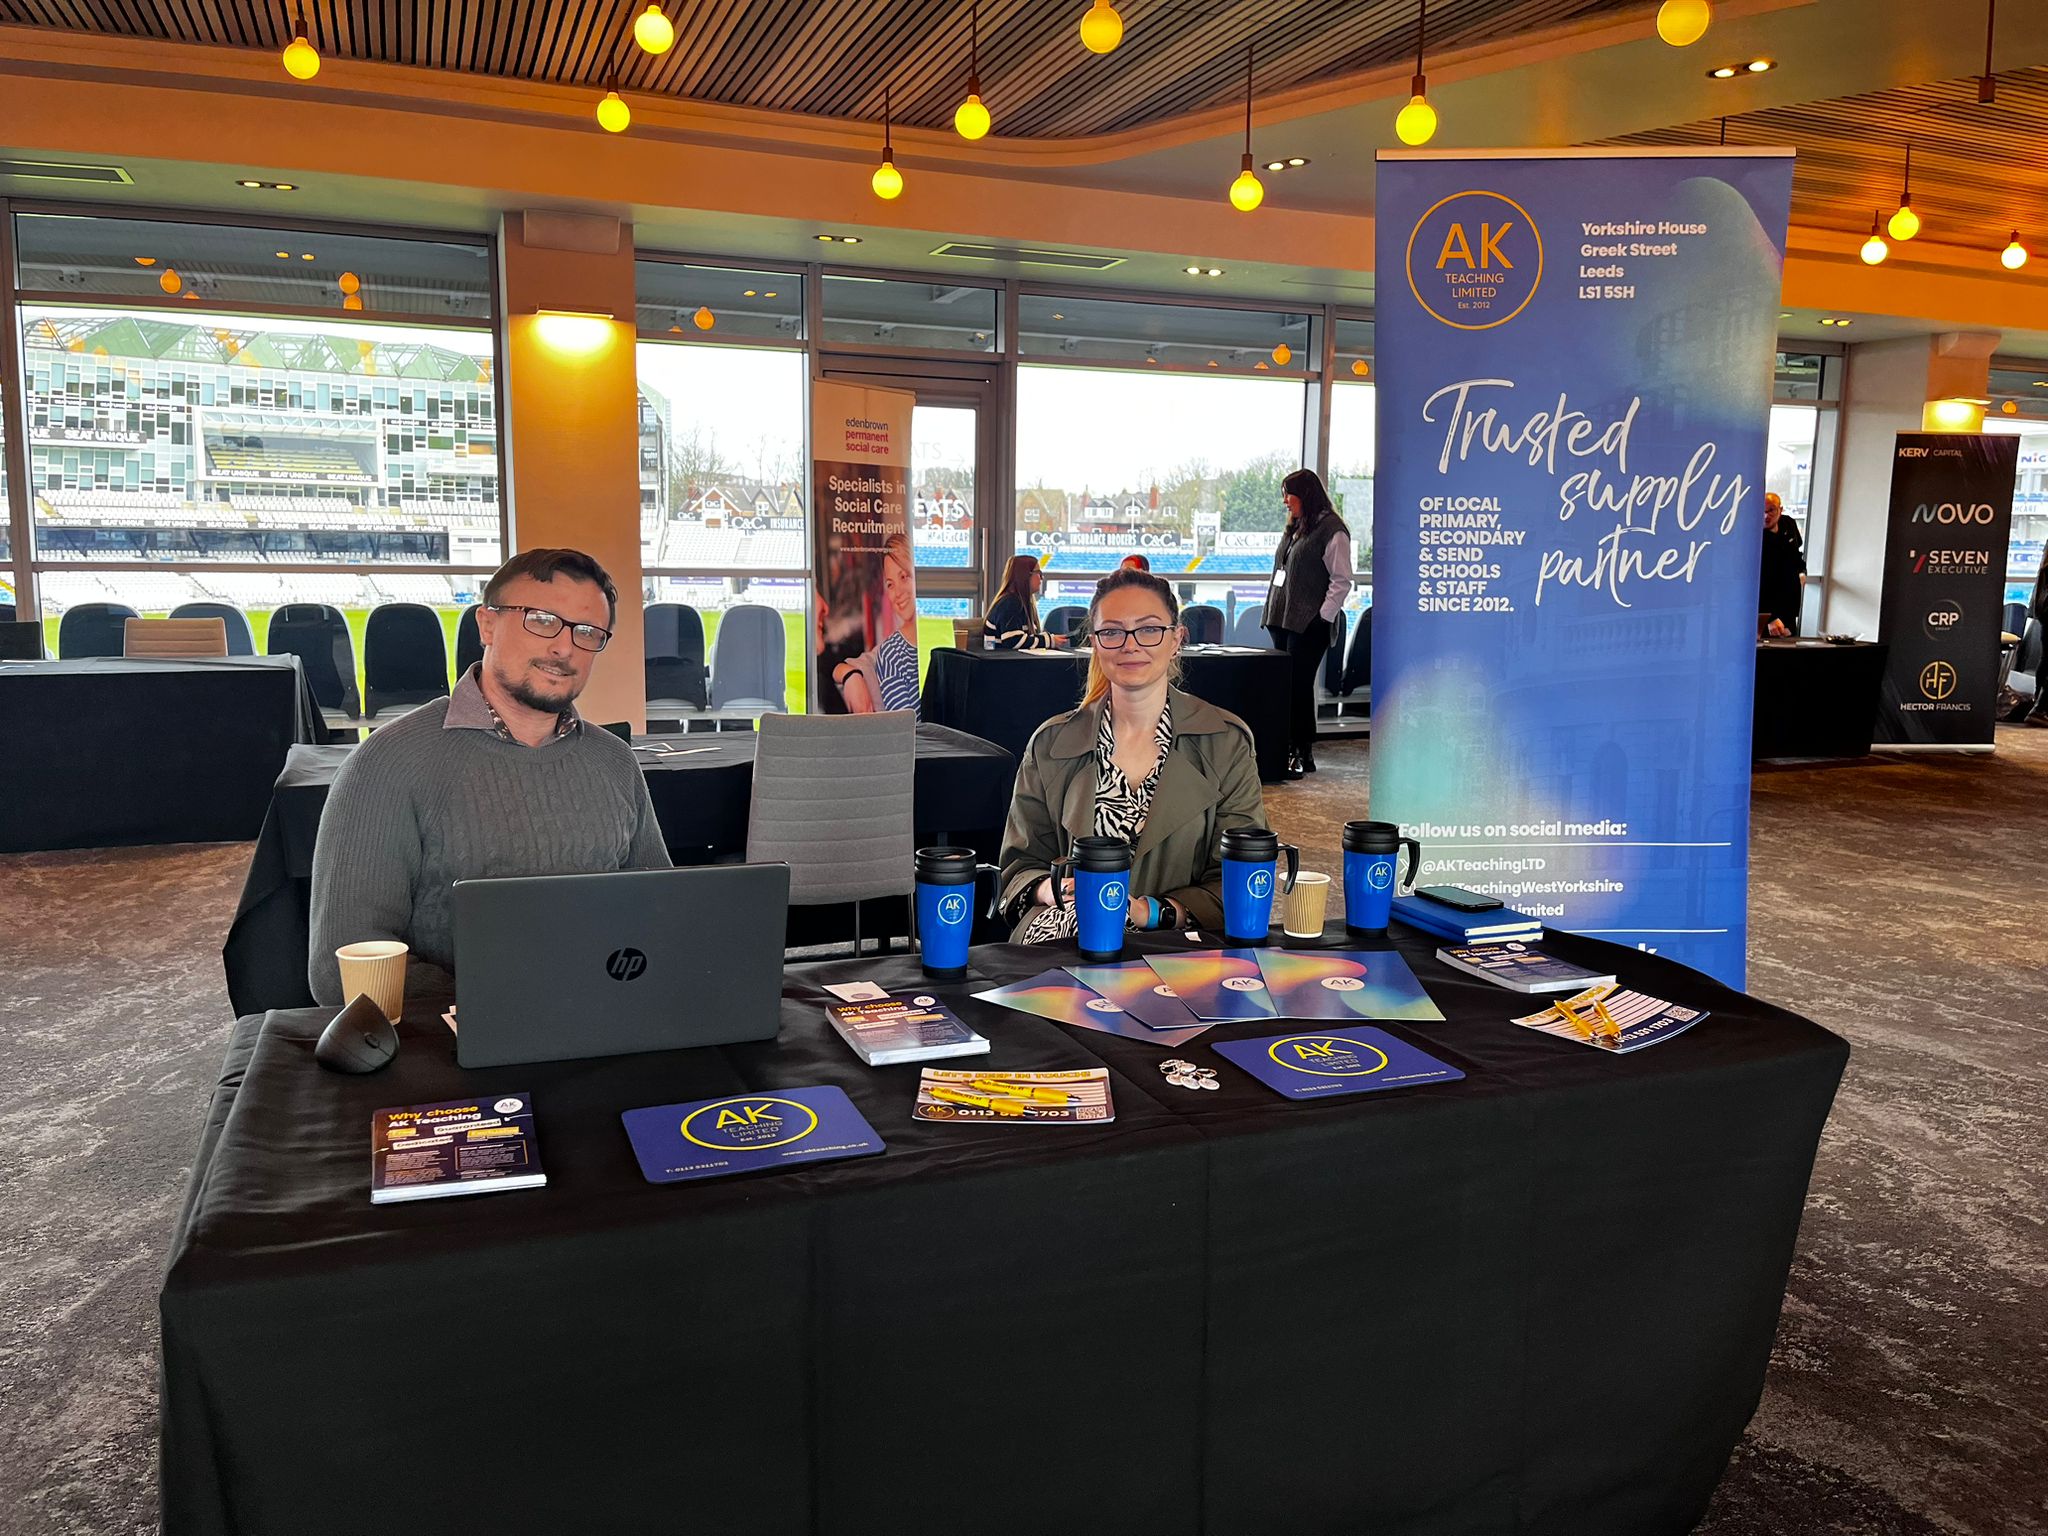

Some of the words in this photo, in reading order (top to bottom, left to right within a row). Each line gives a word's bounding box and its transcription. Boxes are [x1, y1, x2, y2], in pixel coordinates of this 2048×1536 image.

[1582, 221, 1656, 236] Yorkshire
[1658, 222, 1707, 235] House
[1436, 223, 1514, 269] AK
[1580, 244, 1627, 257] Greek
[1630, 243, 1678, 256] Street
[1445, 273, 1504, 284] TEACHING
[1580, 265, 1624, 278] Leeds
[1452, 287, 1497, 298] LIMITED
[1579, 286, 1601, 299] LS1
[1604, 286, 1635, 299] 5SH
[1473, 301, 1491, 309] 2012
[845, 418, 889, 431] edenbrown
[1423, 379, 1640, 474] Trusted
[65, 431, 93, 441] SEAT
[95, 432, 140, 443] UNIQUE
[845, 430, 889, 443] permanent
[846, 442, 870, 453] social
[871, 444, 889, 455] care
[1899, 448, 1929, 457] KERV
[1933, 449, 1962, 457] CAPITAL
[829, 475, 893, 494] Specialists
[897, 480, 906, 494] in
[1560, 442, 1751, 535] supply
[834, 497, 871, 513] Social
[874, 499, 902, 514] Care
[914, 498, 965, 520] EATS
[1420, 497, 1444, 511] OF
[1447, 497, 1501, 511] LOCAL
[1912, 503, 1994, 525] NOVO
[833, 518, 905, 535] Recruitment
[1420, 514, 1501, 530] PRIMARY,
[1070, 533, 1106, 545] INSURANCE
[1107, 534, 1136, 546] BROKERS
[1419, 531, 1526, 545] SECONDARY
[1419, 547, 1433, 561] &
[1437, 547, 1483, 561] SEND
[1929, 550, 1989, 565] SEVEN
[1419, 564, 1501, 578] SCHOOLS
[1535, 524, 1711, 607] partner
[1928, 565, 1988, 574] EXECUTIVE
[1418, 581, 1433, 595] &
[1436, 581, 1487, 594] STAFF
[1418, 598, 1470, 612] SINCE
[1473, 597, 1514, 612] 2012.
[1928, 612, 1959, 626] CRP
[1900, 703, 1934, 711] HECTOR
[1936, 703, 1971, 711] FRANCIS
[1399, 822, 1457, 838] Follow
[1461, 825, 1481, 837] us
[1485, 824, 1506, 837] on
[1510, 821, 1561, 836] social
[1564, 820, 1627, 836] media:
[1421, 858, 1545, 875] @AKTeachingLTD
[1423, 880, 1624, 897] TeachingWestYorkshire
[945, 899, 960, 910] AK
[607, 947, 647, 980] hp
[1293, 1041, 1353, 1059] AK
[388, 1112, 422, 1121] Why
[427, 1106, 478, 1117] choose
[388, 1120, 409, 1128] AK
[414, 1113, 482, 1125] Teaching
[716, 1103, 783, 1129] AK
[723, 1121, 783, 1133] TEACHING
[731, 1127, 779, 1138] LIMITED
